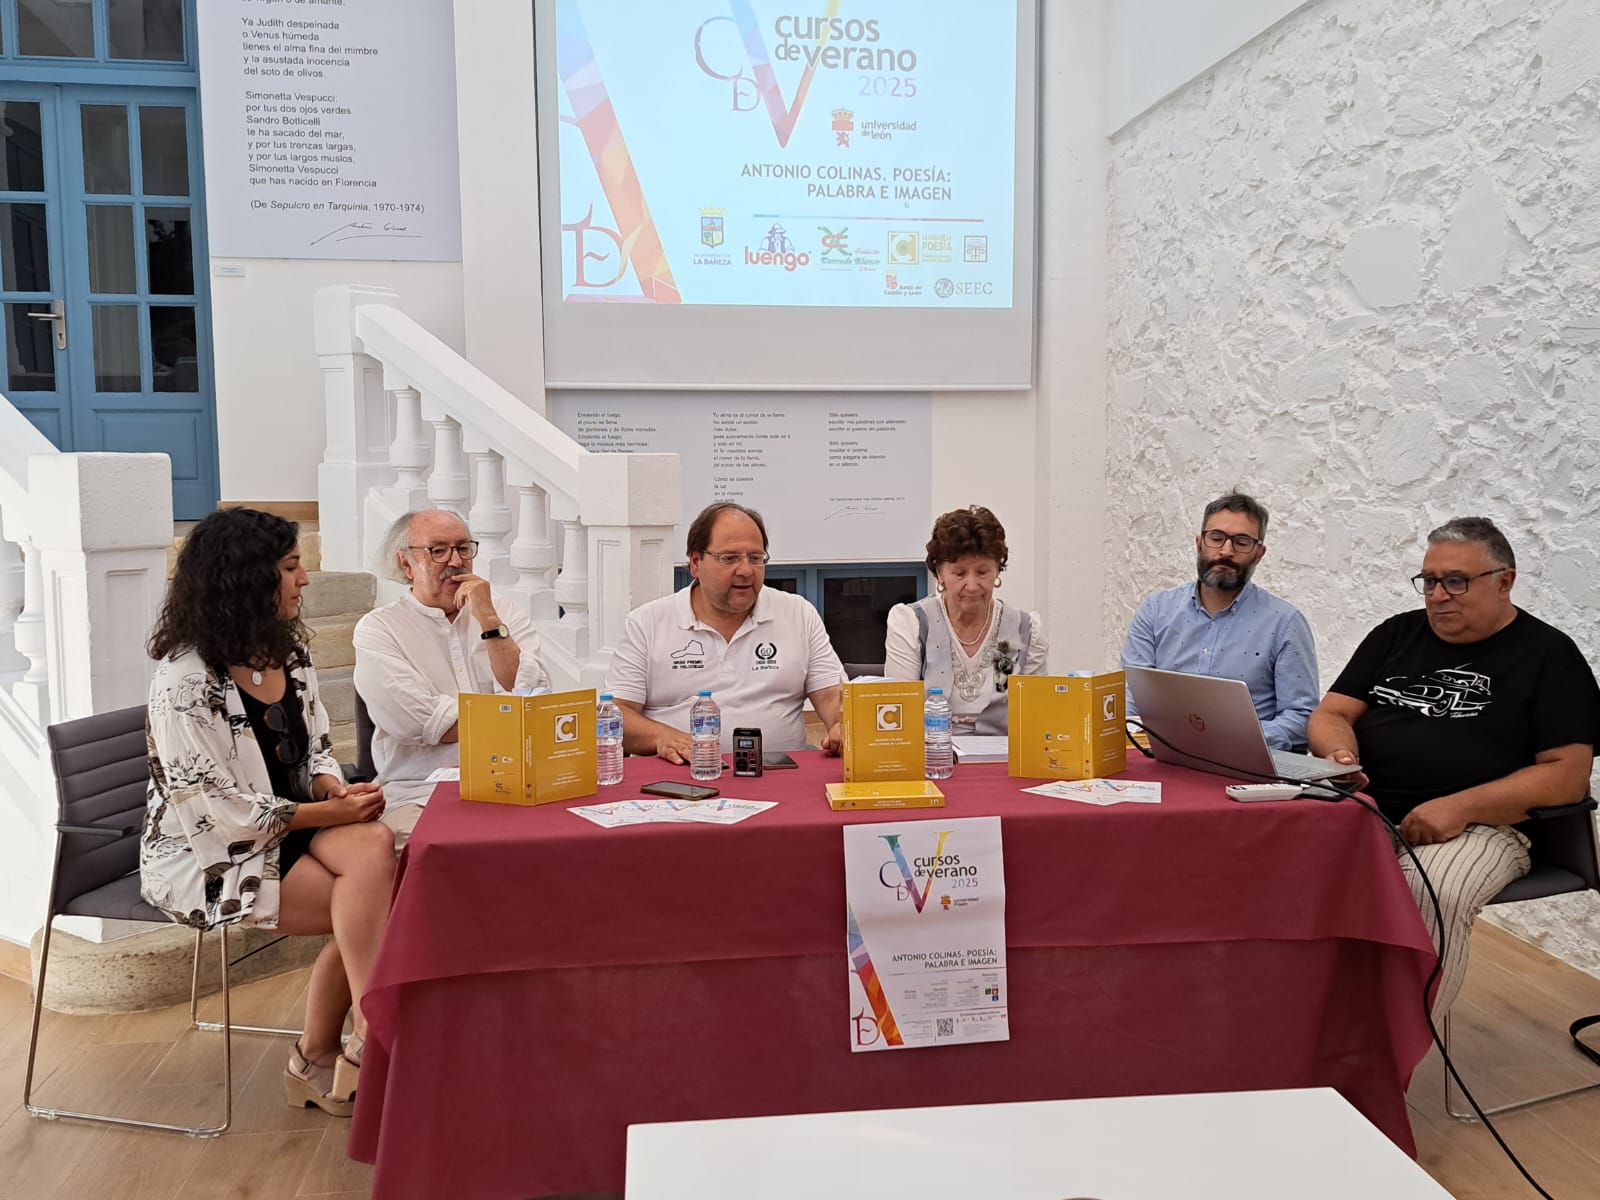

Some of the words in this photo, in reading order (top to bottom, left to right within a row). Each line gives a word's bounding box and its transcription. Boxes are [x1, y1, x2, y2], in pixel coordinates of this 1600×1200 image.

[241, 17, 254, 27] Ya
[256, 18, 284, 28] Judith
[286, 19, 340, 31] despeinada
[775, 15, 880, 42] cursos
[250, 30, 280, 40] Venus
[282, 31, 320, 41] húmeda
[243, 42, 271, 52] tienes
[273, 43, 281, 52] el
[284, 43, 306, 53] alma
[309, 44, 326, 54] fina
[328, 45, 342, 54] del
[344, 45, 378, 55] mimbre
[243, 55, 249, 64] y
[252, 54, 260, 63] la
[262, 54, 304, 65] asustada
[307, 56, 350, 67] inocencia
[775, 39, 800, 61] de
[802, 46, 917, 72] verano
[244, 66, 258, 76] del
[261, 67, 281, 76] soto
[283, 67, 294, 77] de
[858, 76, 917, 98] 2025
[245, 91, 292, 101] Simonetta
[246, 104, 261, 114] por
[263, 103, 278, 113] tus
[280, 104, 297, 113] dos
[299, 104, 318, 115] ojos
[321, 105, 352, 115] verdes
[246, 115, 280, 125] Sandro
[282, 116, 321, 126] Botticelli
[861, 120, 916, 132] universidad
[247, 127, 256, 136] te
[258, 128, 270, 137] ha
[272, 128, 306, 138] sacado
[308, 129, 322, 138] del
[871, 129, 892, 140] león
[247, 141, 253, 150] y
[256, 141, 271, 151] por
[273, 140, 287, 150] tus
[289, 141, 323, 150] trenzas
[248, 153, 254, 162] y
[256, 153, 272, 163] por
[274, 152, 288, 162] tus
[290, 153, 319, 164] largos
[249, 164, 295, 173] Simonetta
[298, 164, 339, 176] Vespucci
[741, 164, 811, 179] ANTONIO
[817, 166, 886, 182] COLINAS.
[893, 165, 951, 183] POESÍA:
[249, 177, 267, 187] que
[269, 176, 286, 185] has
[288, 176, 319, 186] nacido
[335, 177, 377, 187] Florencia
[808, 184, 876, 199] PALABRA
[881, 186, 888, 200] E
[895, 186, 951, 201] IMAGEN
[250, 199, 268, 210] (De
[270, 200, 310, 211] Sepulcro
[374, 202, 425, 213] 1970-1974)
[745, 246, 810, 272] luengo
[955, 282, 992, 295] SEEC
[914, 854, 960, 868] cursos
[914, 866, 925, 877] de
[927, 865, 977, 878] verano
[952, 878, 978, 888] 2025
[892, 952, 926, 962] ANTONIO
[929, 951, 965, 960] COLINAS.
[967, 947, 997, 957] POESÍA:
[925, 960, 958, 968] PALABRA
[961, 958, 966, 966] E
[968, 956, 998, 966] IMAGEN
